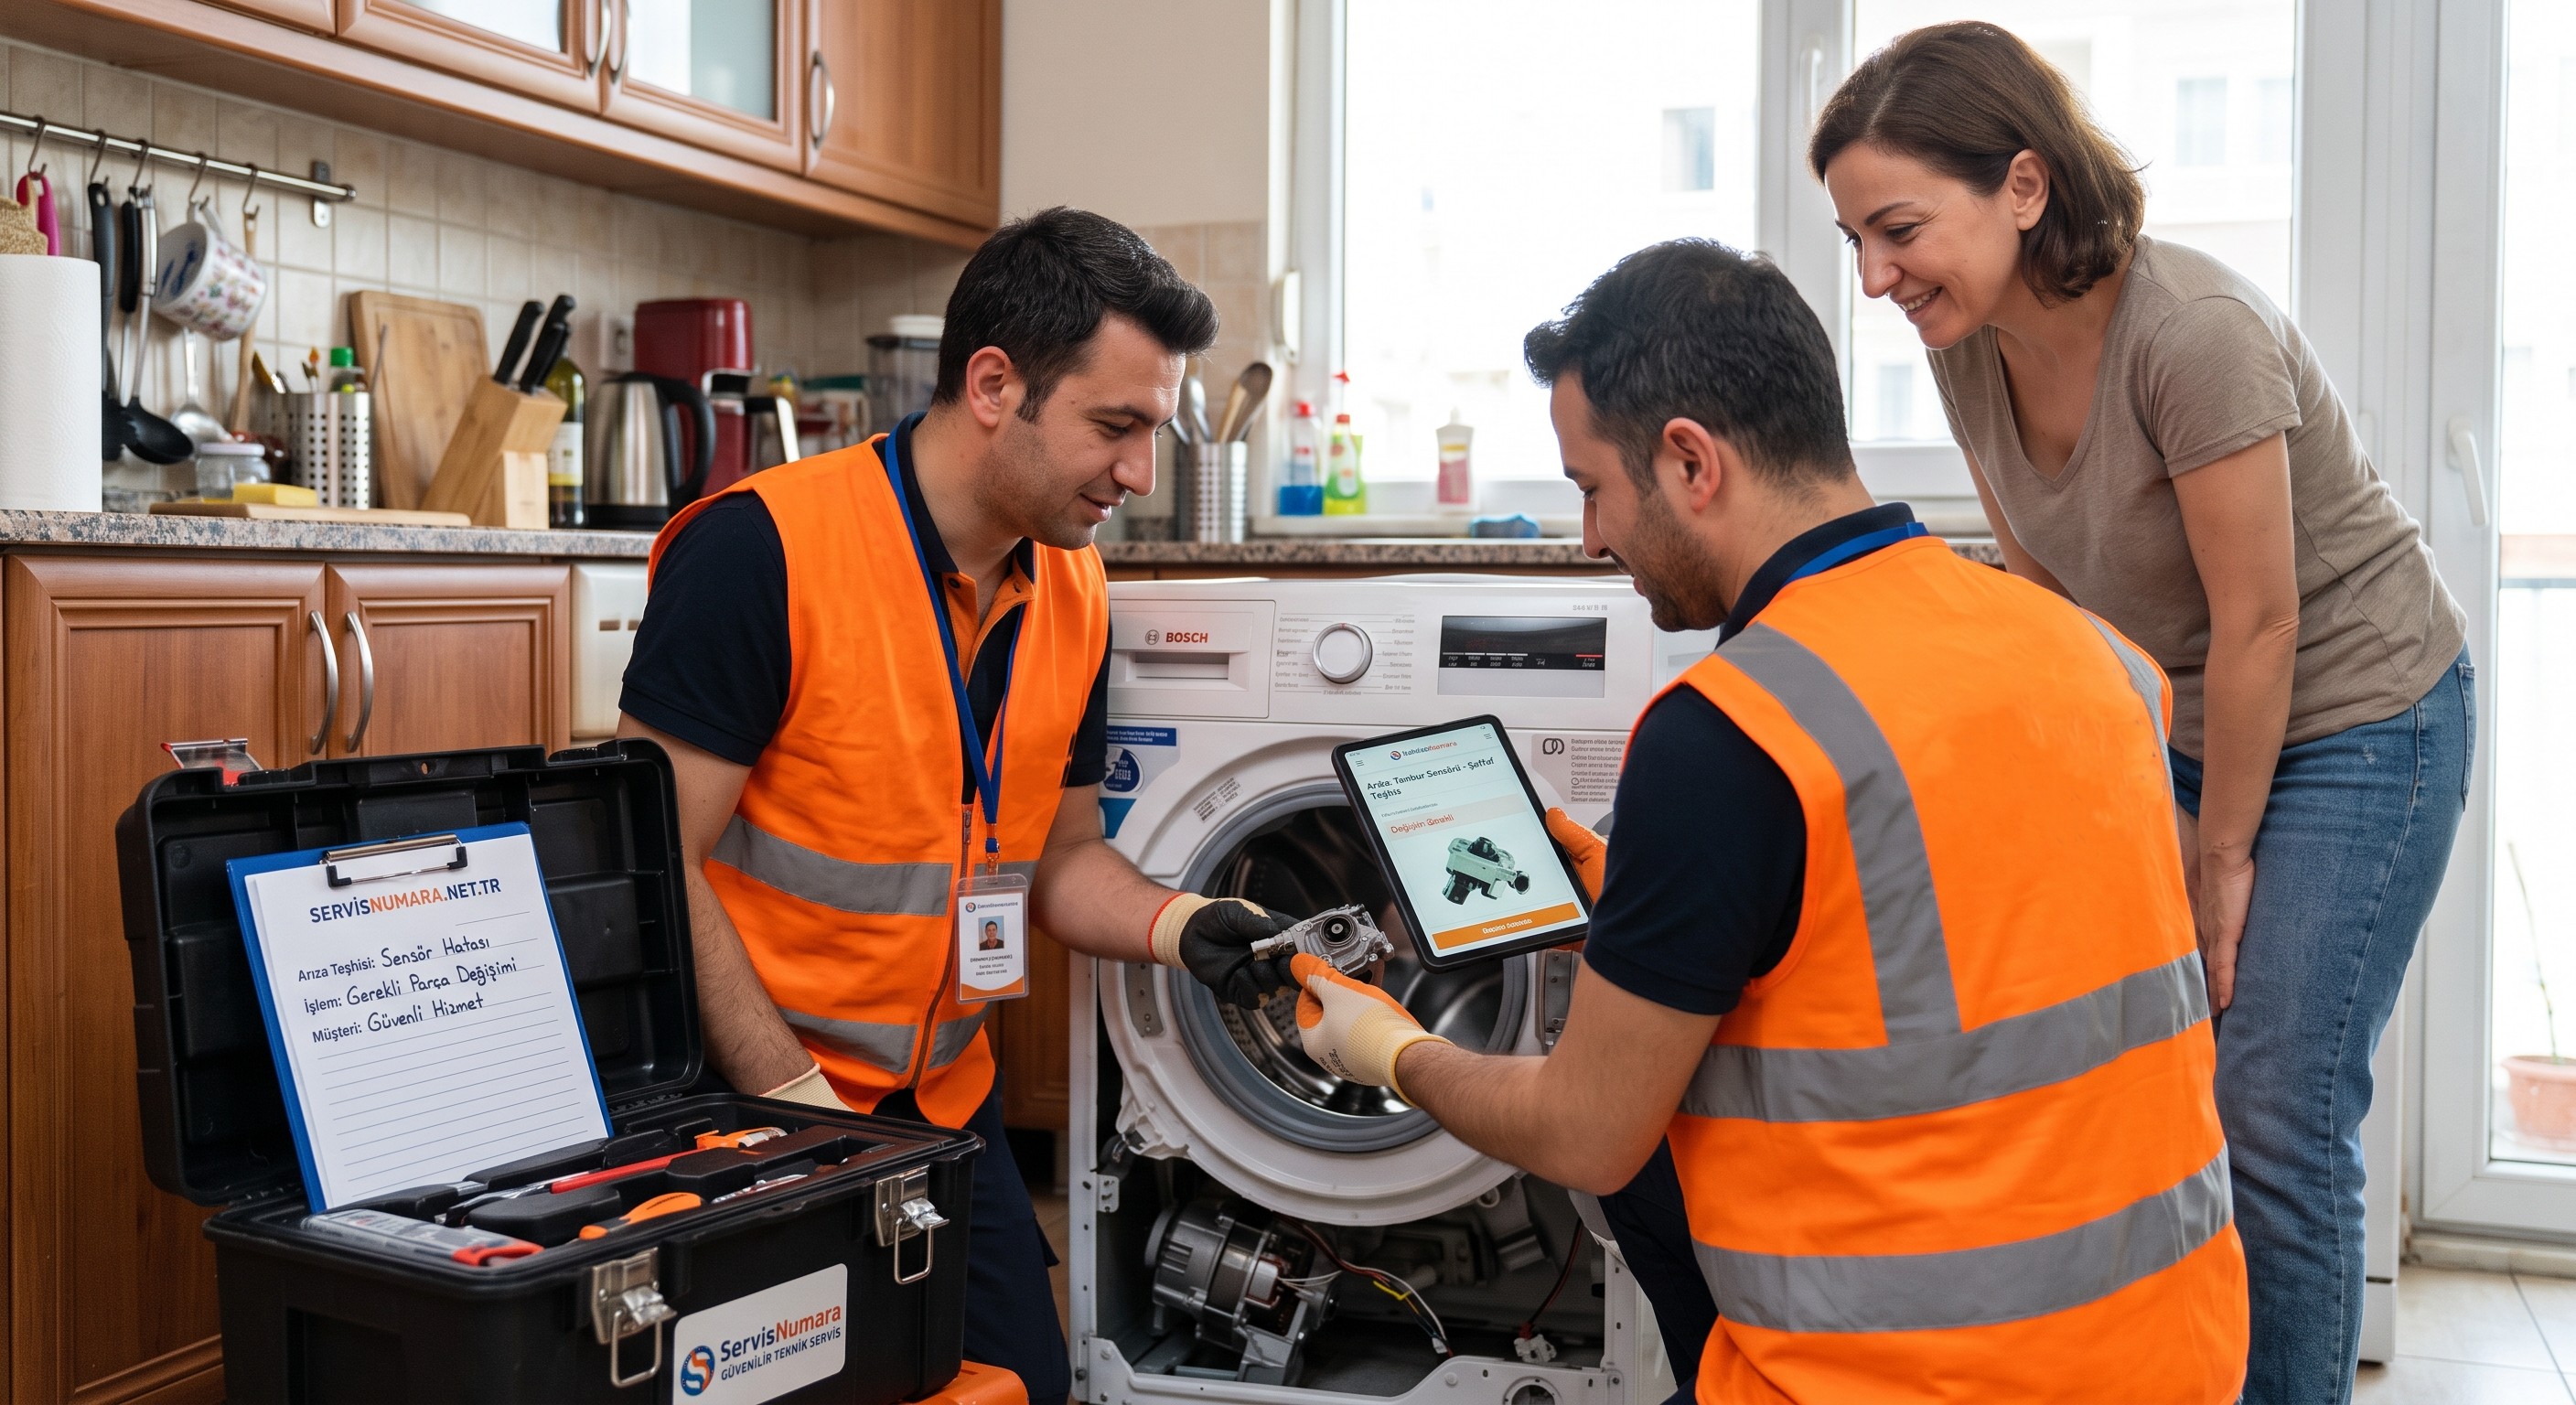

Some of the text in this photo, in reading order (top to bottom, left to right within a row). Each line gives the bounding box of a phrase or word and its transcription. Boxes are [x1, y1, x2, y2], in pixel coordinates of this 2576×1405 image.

[1165, 632, 1208, 643] BOSCH
[309, 878, 501, 923] SERVİSNUMARA.NET.TR
[297, 936, 490, 982] Arıza Teşhisi: Sensör Hatası
[304, 957, 517, 1015] İşlem: Gerekli Parça Değişimi
[312, 992, 484, 1044] Müşteri: Güvenli Hizmet
[721, 1305, 842, 1362] ServisNumara
[721, 1326, 841, 1380] GÜVENİLİR TEKNİK SERVİS
